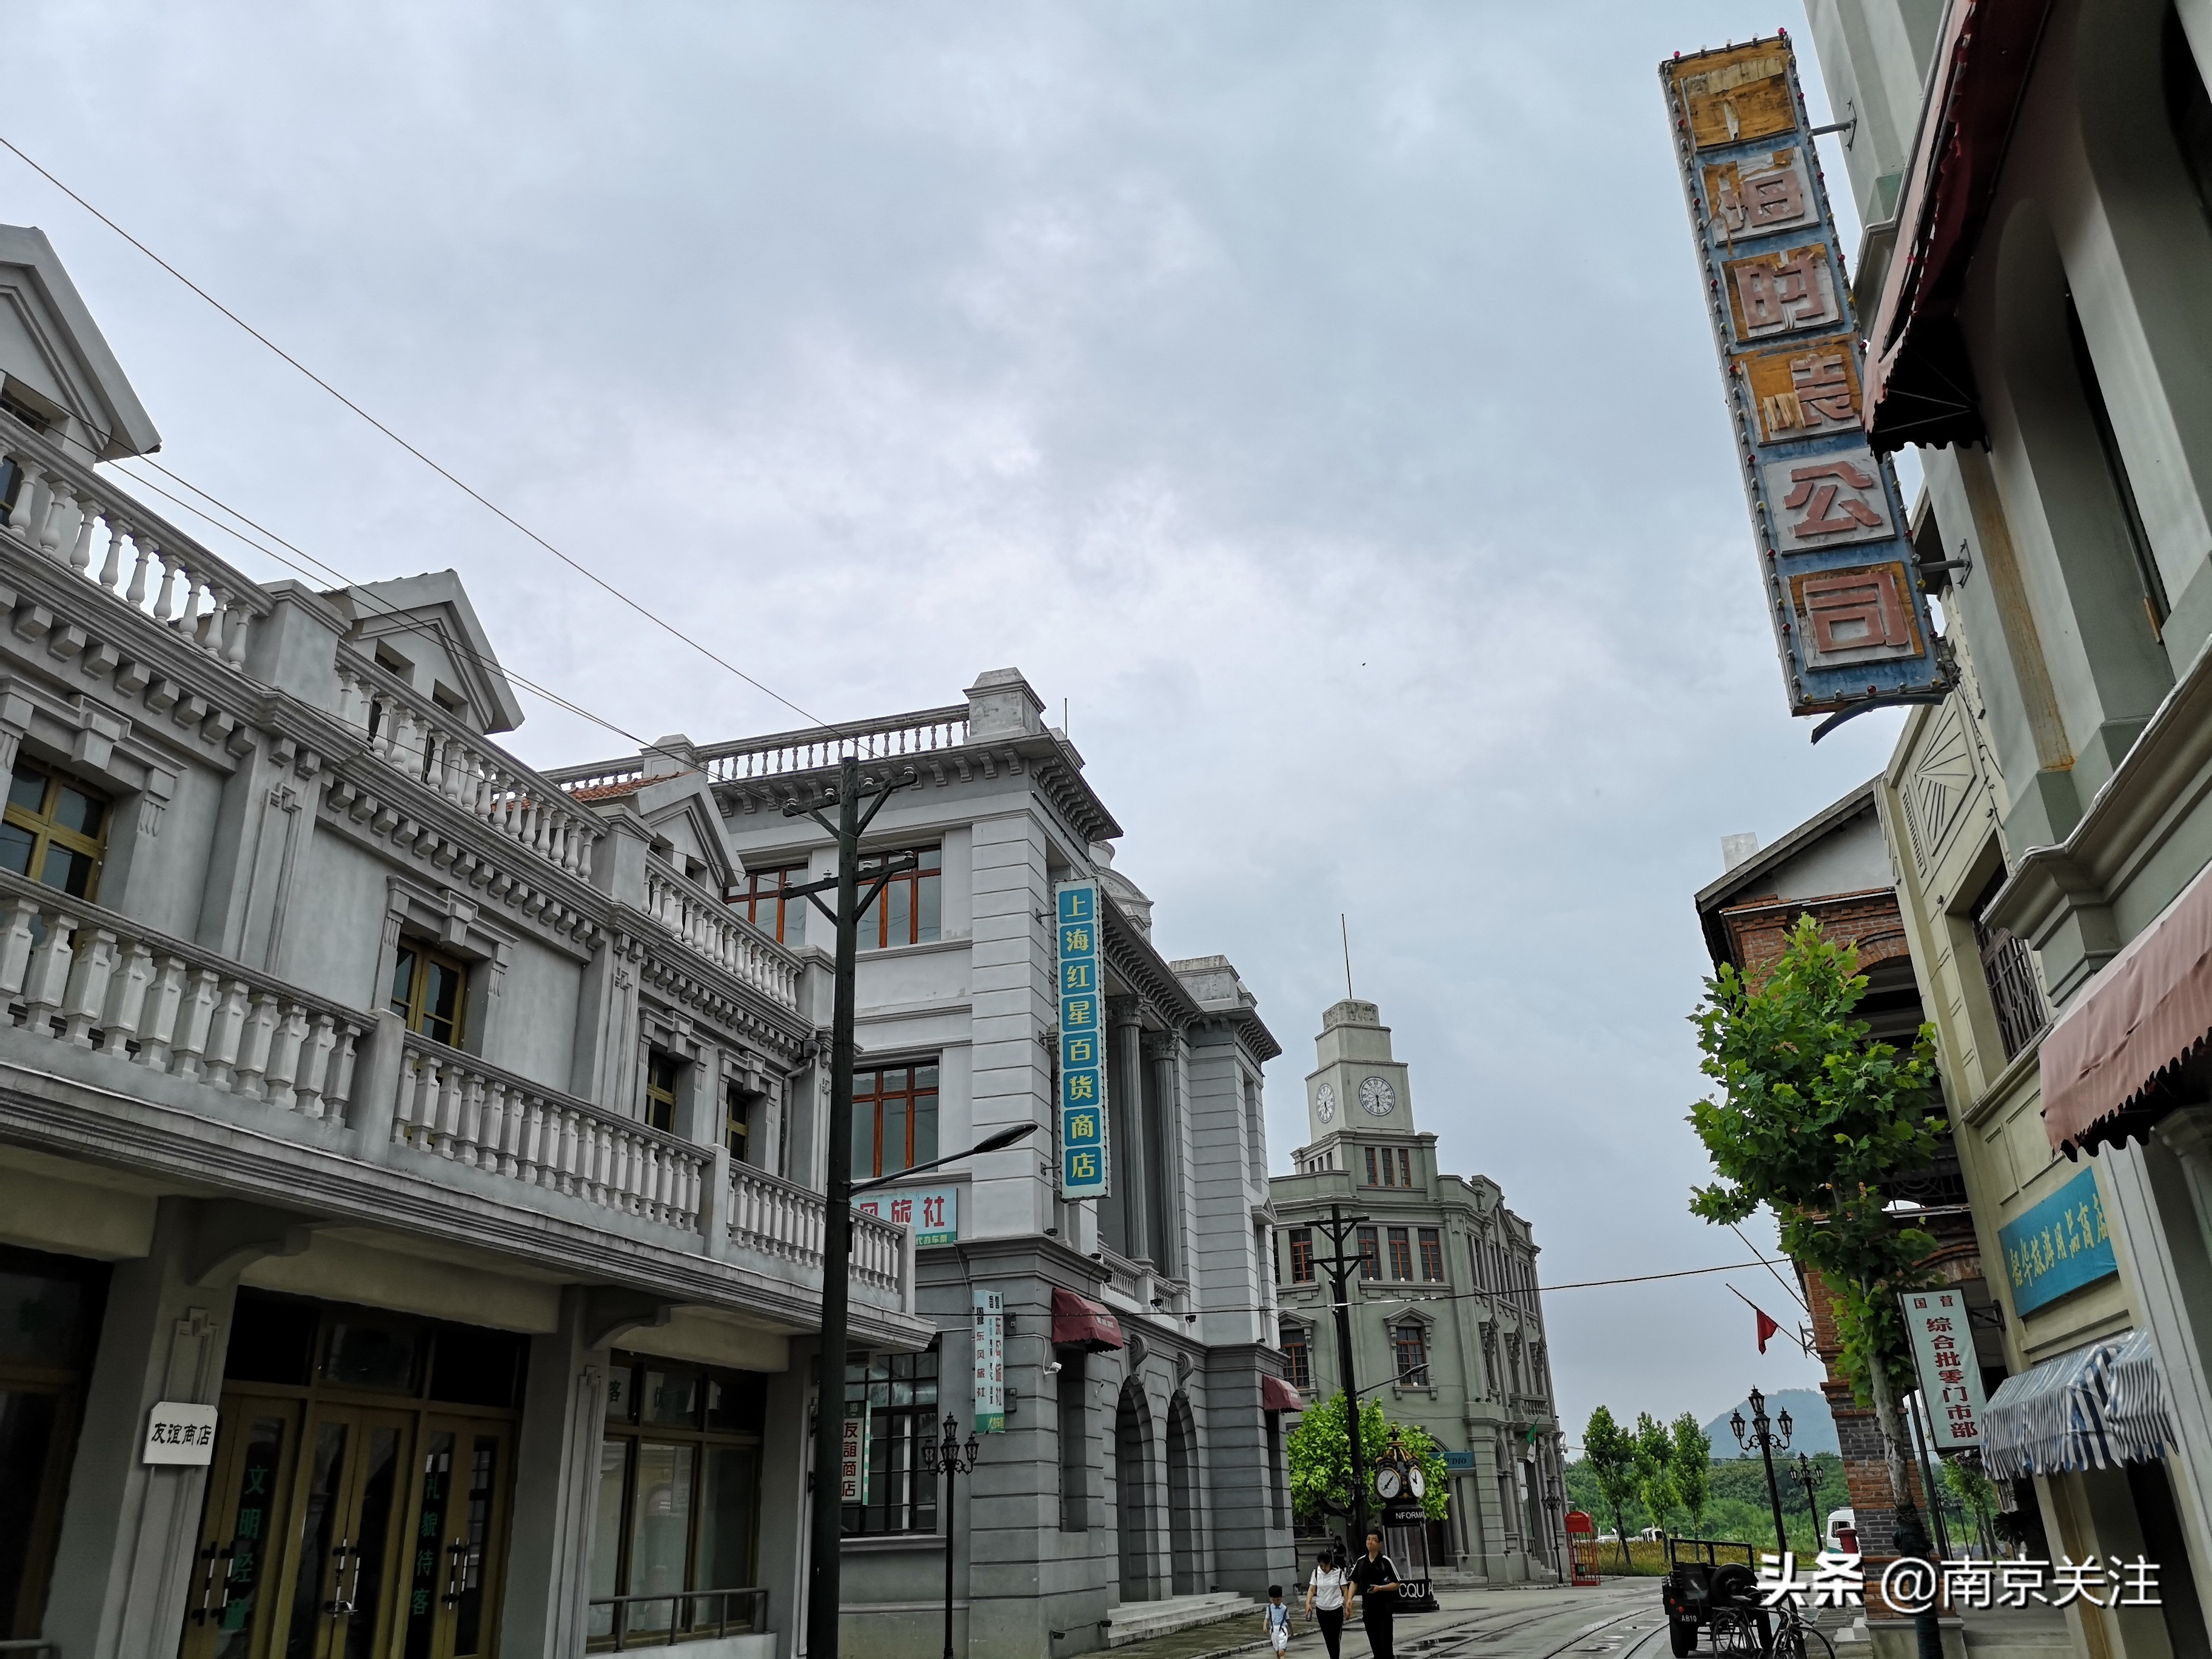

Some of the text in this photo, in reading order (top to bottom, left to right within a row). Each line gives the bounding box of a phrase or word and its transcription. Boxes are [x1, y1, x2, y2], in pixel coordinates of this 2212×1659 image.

[1065, 894, 1095, 1179] 上海红星百货商店
[1913, 1295, 1954, 1309] 国营
[152, 1421, 212, 1446] 友谊商店
[1926, 1317, 1979, 1439] 综合批零门市部
[411, 1473, 440, 1616] 礼貌待客
